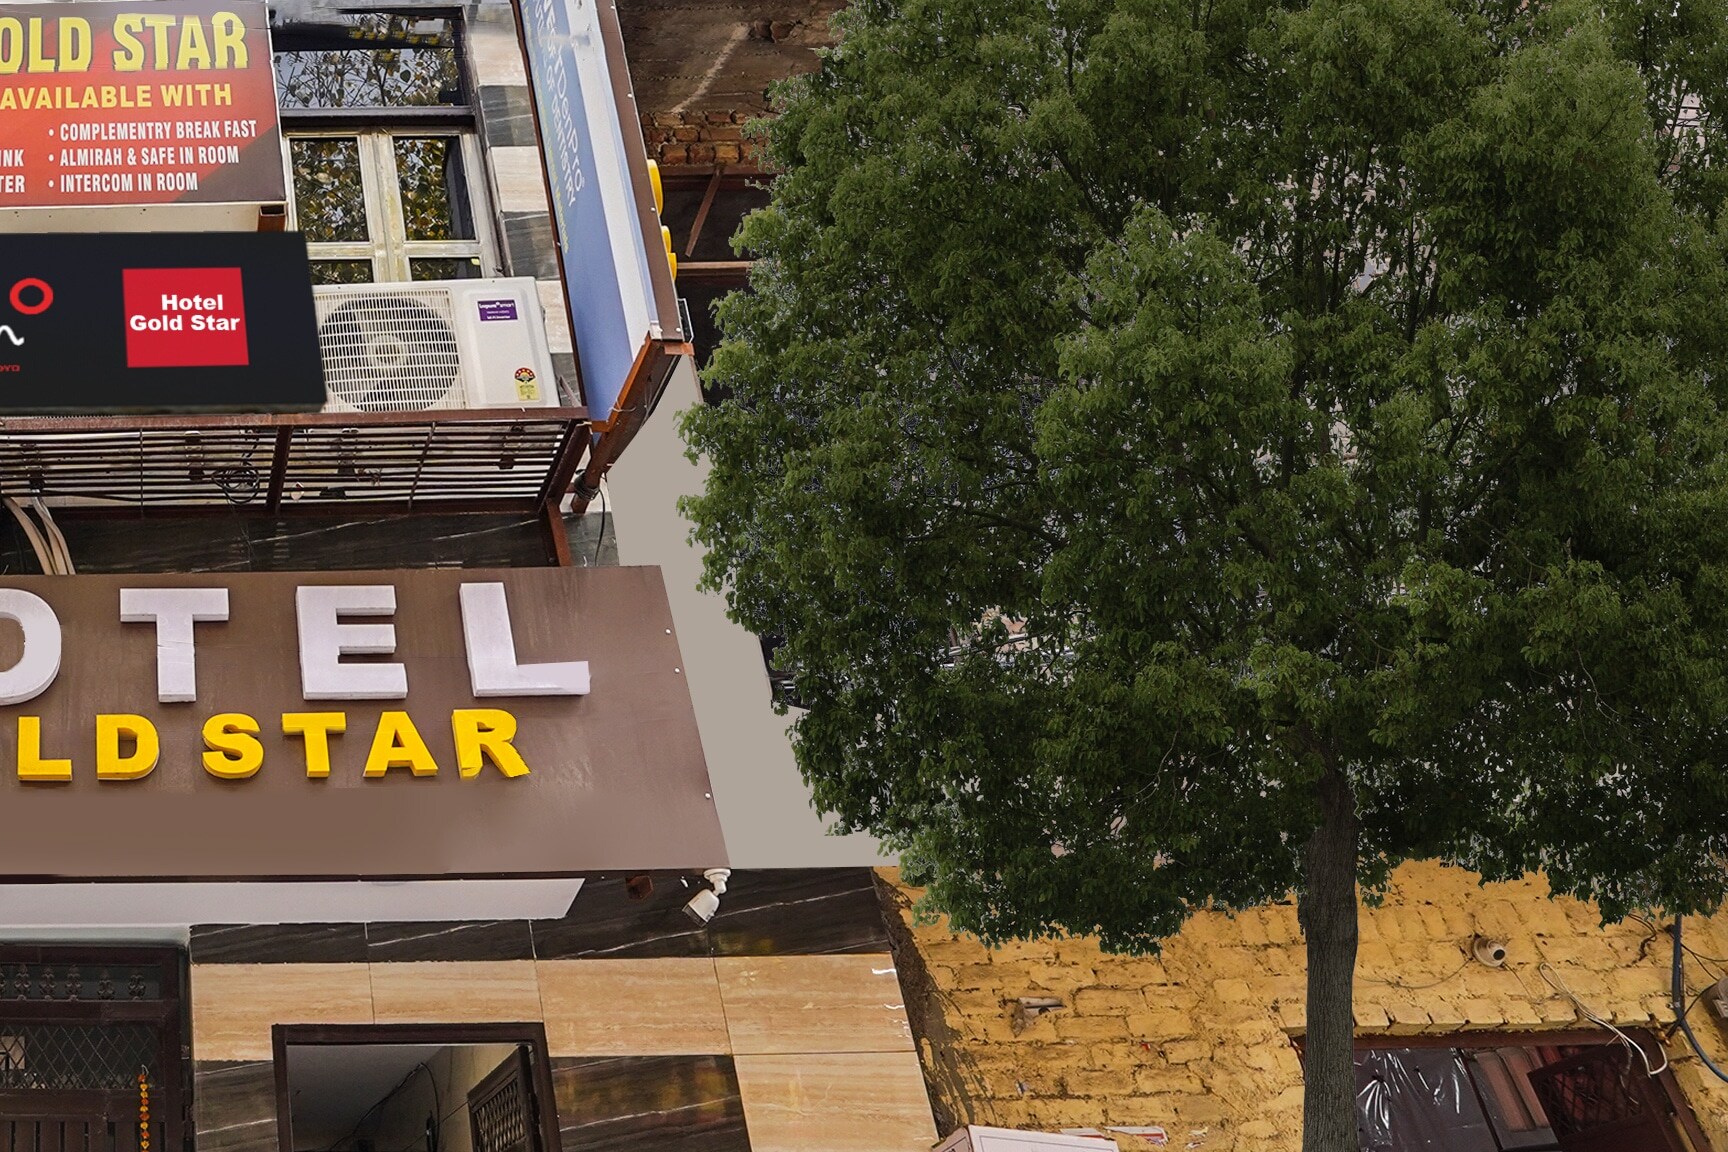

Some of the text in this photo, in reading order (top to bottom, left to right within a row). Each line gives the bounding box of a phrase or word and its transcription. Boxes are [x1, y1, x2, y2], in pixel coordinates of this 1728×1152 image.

[113, 10, 249, 71] STAR
[0, 85, 152, 110] AVAILABLE
[160, 83, 233, 107] WITH
[60, 120, 257, 141] COMPLEMENTRY BREAK FAST
[60, 145, 240, 167] ALMIRAH & SAFE IN ROOM
[60, 172, 199, 193] INTERCOM IN ROOM
[161, 294, 223, 310] Hotel
[130, 314, 241, 331] Gold Star
[202, 709, 530, 779] STAR
